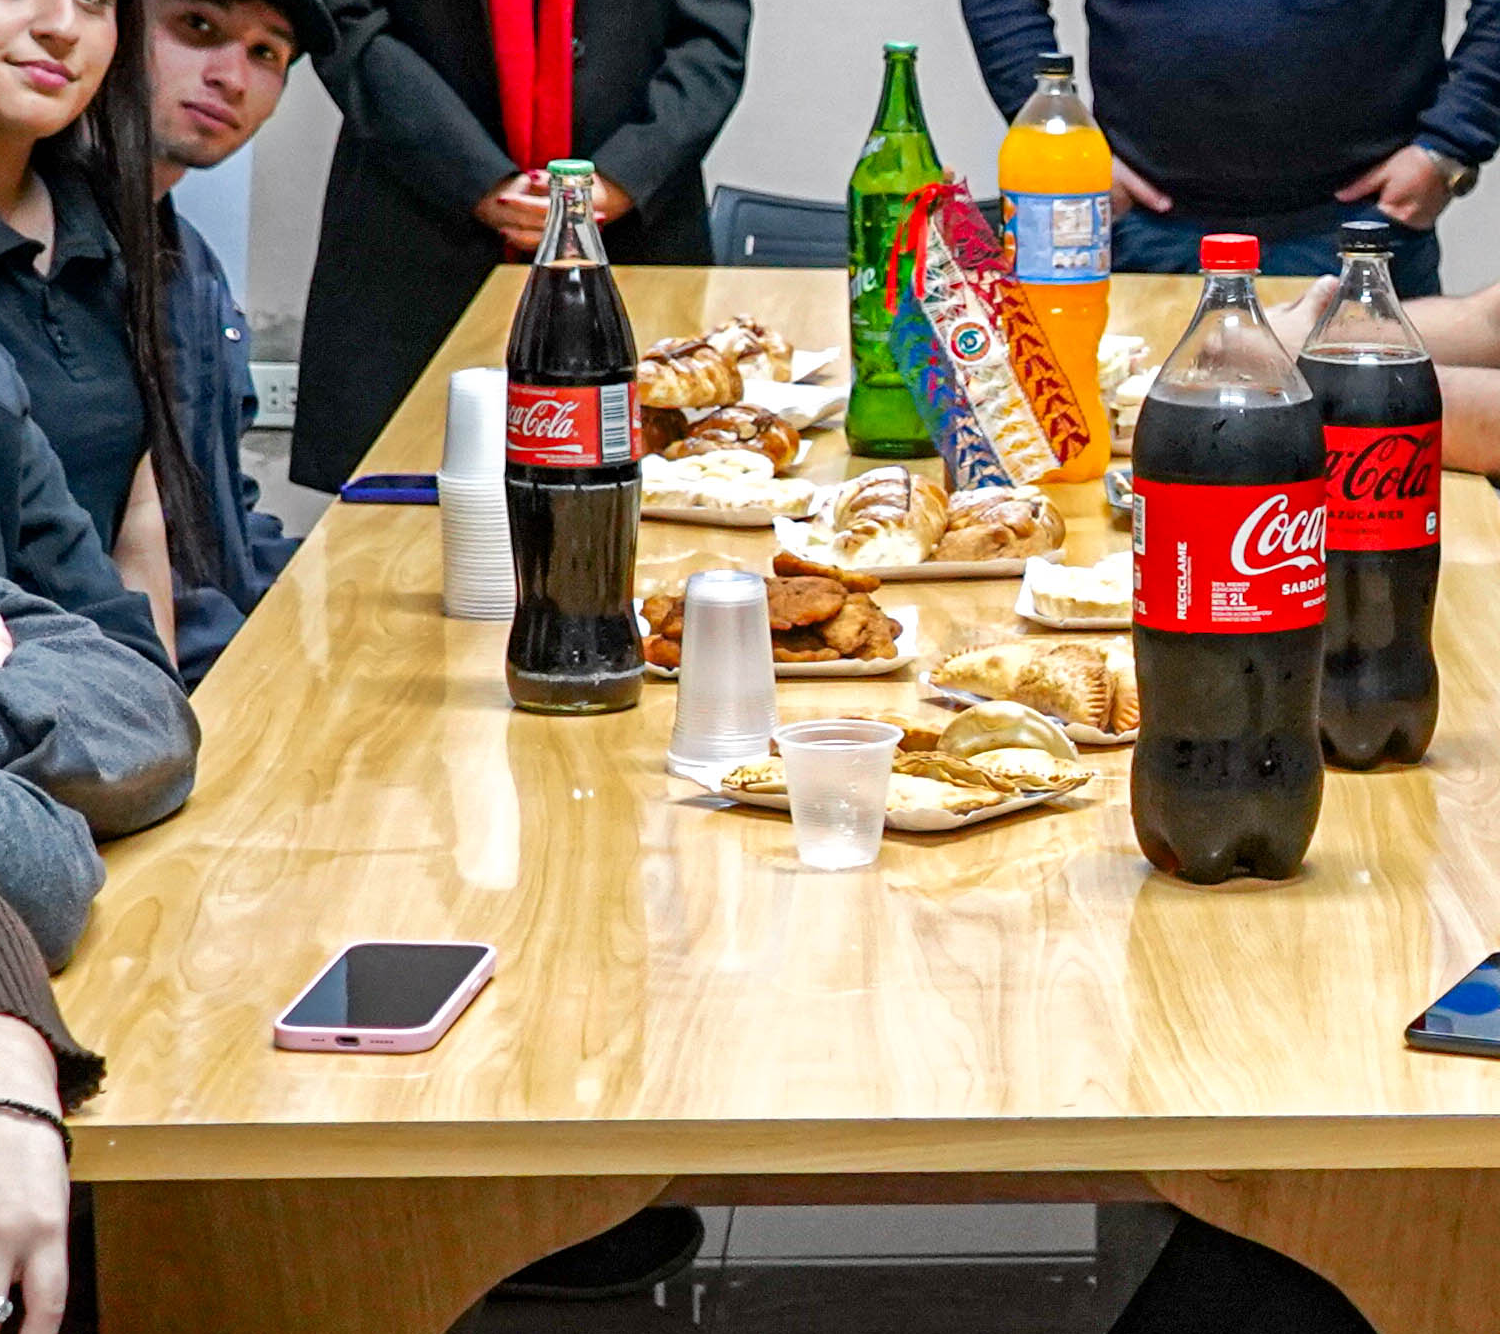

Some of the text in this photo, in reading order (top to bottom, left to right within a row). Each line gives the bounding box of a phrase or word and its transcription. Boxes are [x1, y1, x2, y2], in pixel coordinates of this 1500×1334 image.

[1177, 541, 1188, 620] RECICLAME
[1281, 576, 1319, 595] SABOR
[1229, 592, 1247, 606] 2L
